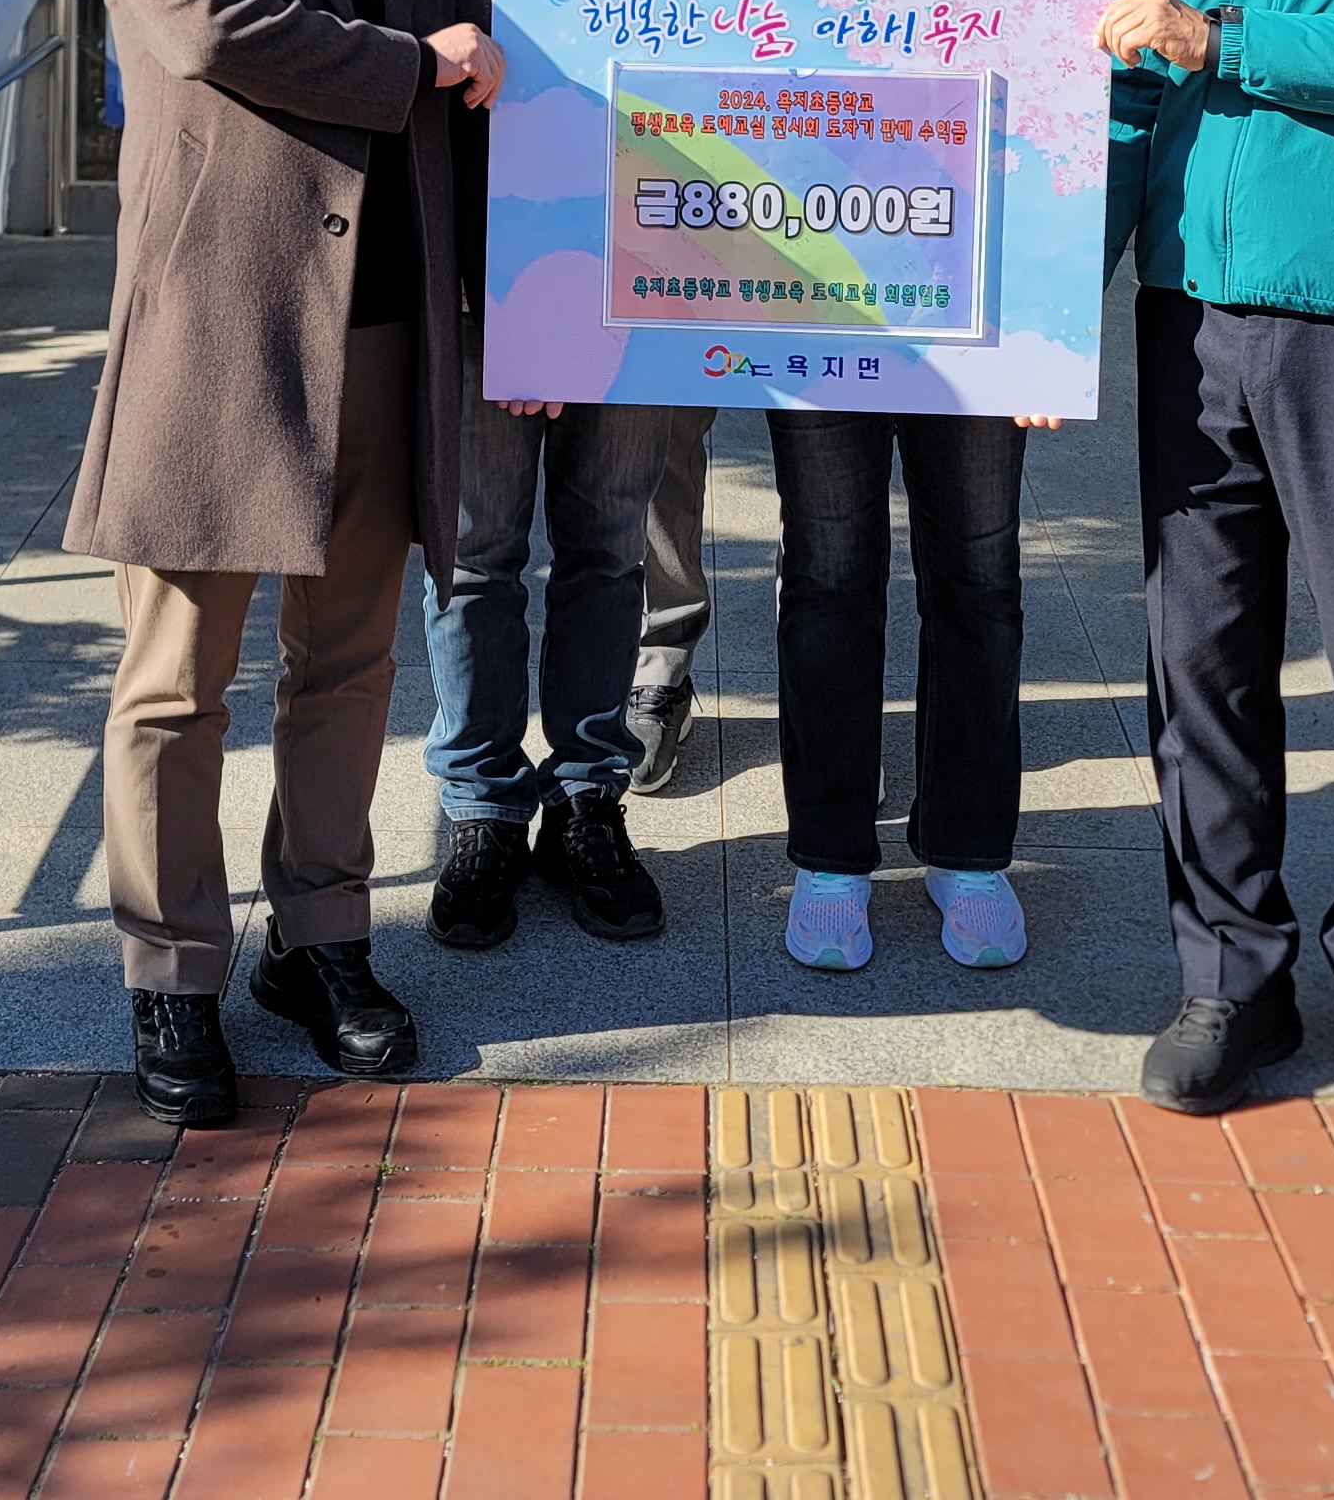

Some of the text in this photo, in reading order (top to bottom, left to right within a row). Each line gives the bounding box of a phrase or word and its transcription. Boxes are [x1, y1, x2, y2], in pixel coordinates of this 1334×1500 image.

[817, 8, 915, 54] 아하!
[924, 3, 1001, 64] 욕지
[718, 90, 875, 116] 2024. 욕지초등학교
[631, 111, 968, 145] 평생교육 도예교실 전시회 도자기 판매 수익금
[634, 177, 956, 239] 금880,000원
[632, 275, 952, 309] 욕지초등학교 평생교육 도예교실 회원일동
[786, 354, 880, 381] 욕지면
